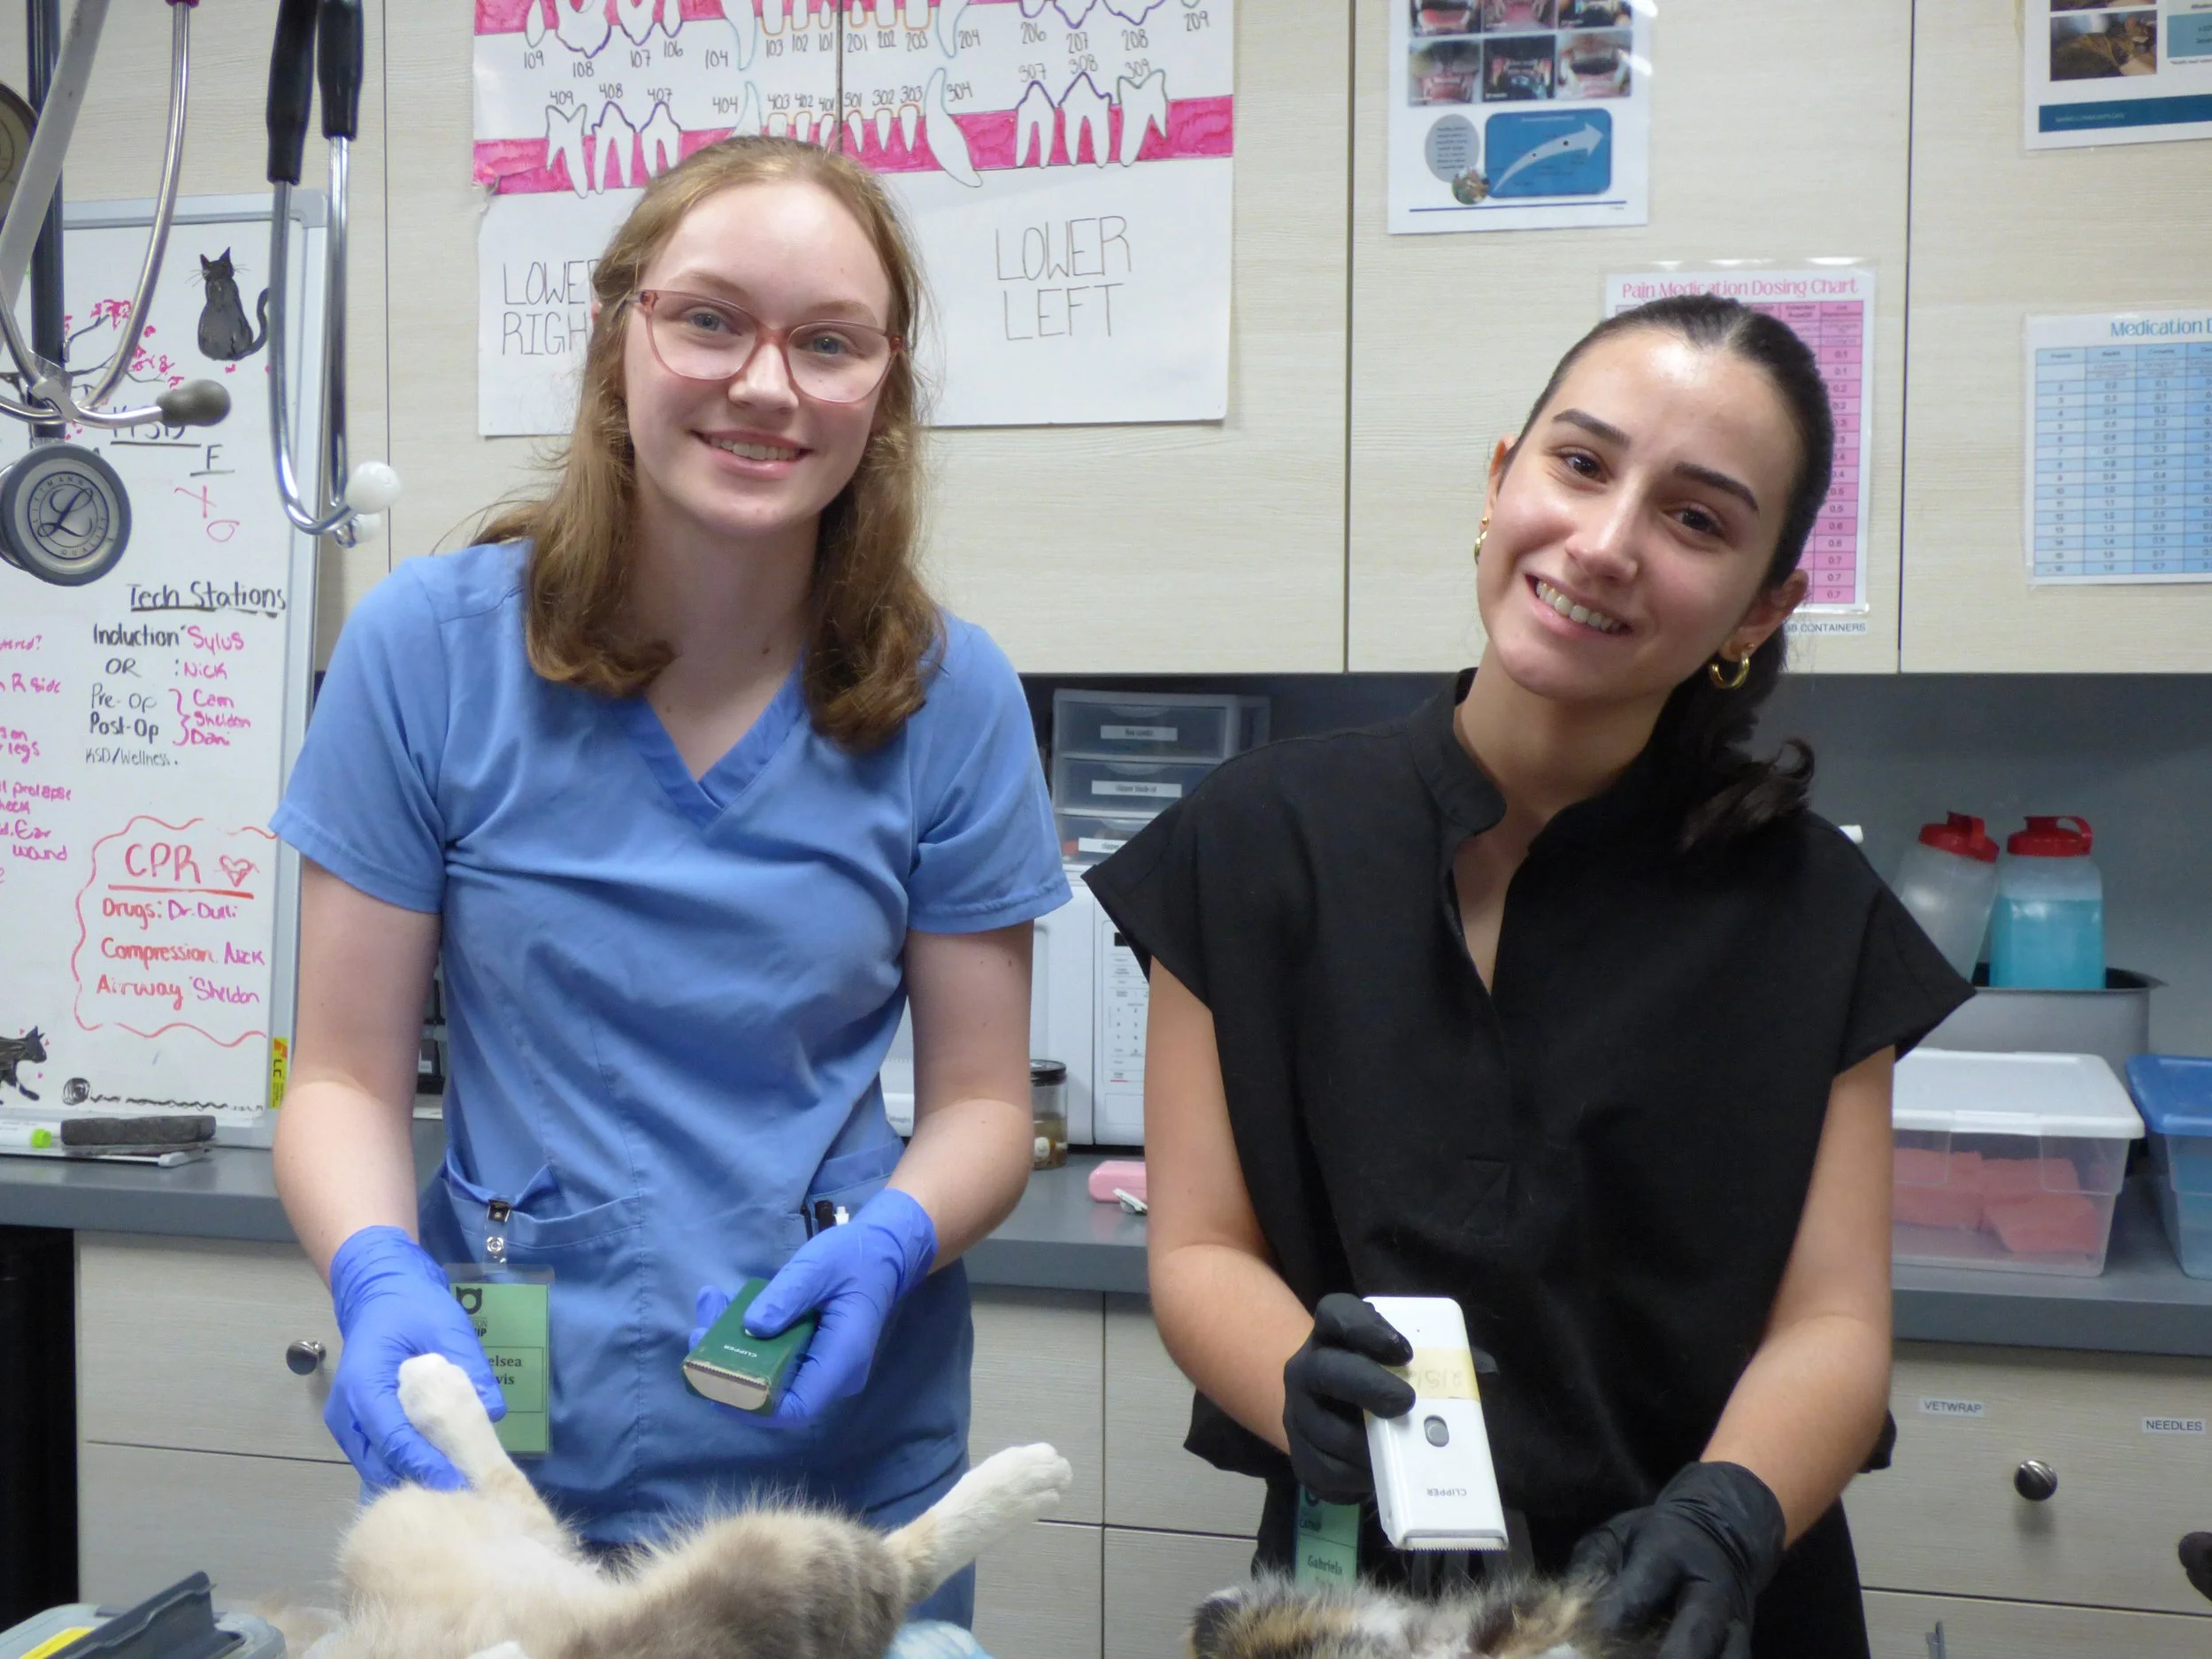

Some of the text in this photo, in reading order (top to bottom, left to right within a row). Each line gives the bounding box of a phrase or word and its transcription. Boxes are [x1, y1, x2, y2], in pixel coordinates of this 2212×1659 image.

[1185, 11, 1210, 31] 209
[818, 33, 833, 51] 101
[905, 31, 927, 51] 203
[958, 29, 980, 49] 204
[1020, 22, 1046, 44] 206
[1066, 32, 1088, 53] 207
[1122, 29, 1148, 50] 208
[664, 41, 683, 58] 106
[765, 39, 783, 58] 103
[792, 34, 809, 52] 102
[847, 33, 867, 53] 201
[524, 50, 544, 69] 109
[630, 50, 651, 68] 107
[705, 50, 728, 69] 104
[1069, 54, 1098, 74] 308
[1125, 58, 1150, 79] 309
[573, 61, 594, 77] 108
[549, 90, 574, 105] 409
[599, 83, 623, 99] 408
[648, 88, 672, 102] 407
[795, 93, 813, 108] 402
[872, 89, 895, 105] 302
[901, 85, 923, 103] 303
[947, 81, 972, 102] 304
[712, 96, 738, 114] 404
[767, 93, 790, 110] 403
[995, 215, 1132, 281] LOWER
[1622, 276, 1859, 303] Pain Medication Dosing Chart
[1003, 282, 1124, 342] LEFT
[503, 311, 588, 356] RIGH
[2110, 318, 2203, 337] Medication
[126, 580, 287, 611] Tech Stations
[1800, 622, 1866, 633] CONTAINERS
[187, 625, 244, 656] Sylus
[183, 661, 227, 680] Nick
[125, 841, 202, 885] CPR
[102, 896, 163, 931] Drugs:
[488, 1355, 522, 1367] elsea
[1924, 1401, 1982, 1413] VETWRAP
[2146, 1419, 2203, 1432] NEEDLES
[1426, 1487, 1467, 1497] CLIPPER
